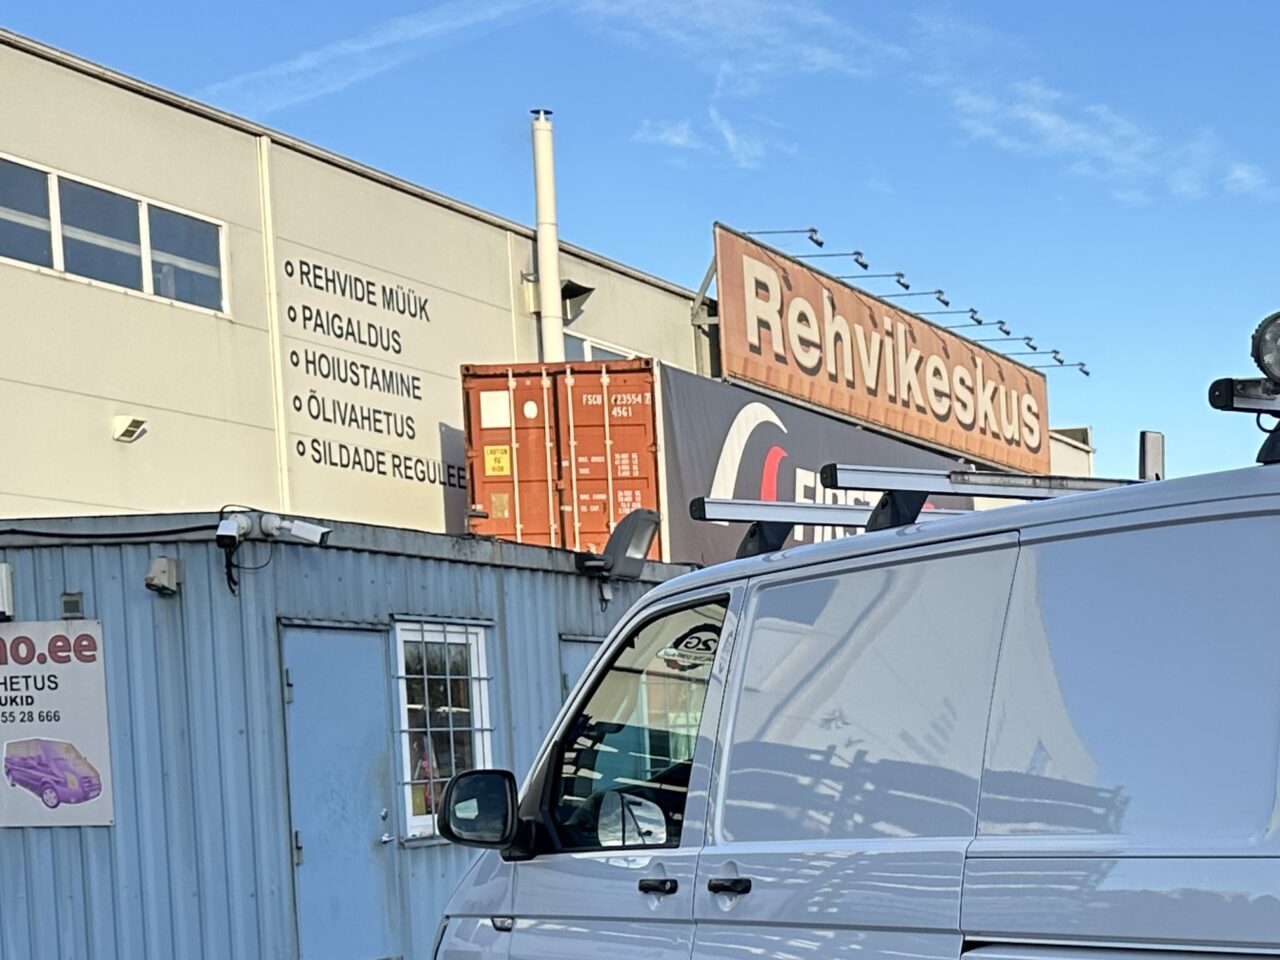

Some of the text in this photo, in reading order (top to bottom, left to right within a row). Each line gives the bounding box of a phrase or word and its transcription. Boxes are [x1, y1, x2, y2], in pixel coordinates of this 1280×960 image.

[300, 260, 430, 322] REHVIDE MÜÜK
[302, 305, 402, 354] PAIGALDUS
[742, 254, 1041, 450] Rehvikeskus
[305, 350, 422, 400] HOIUSTAMINE
[308, 390, 416, 440] ÕLIVAHETUS
[311, 439, 467, 489] SILDADE REGULEE
[1, 710, 61, 724] 55 28 666
